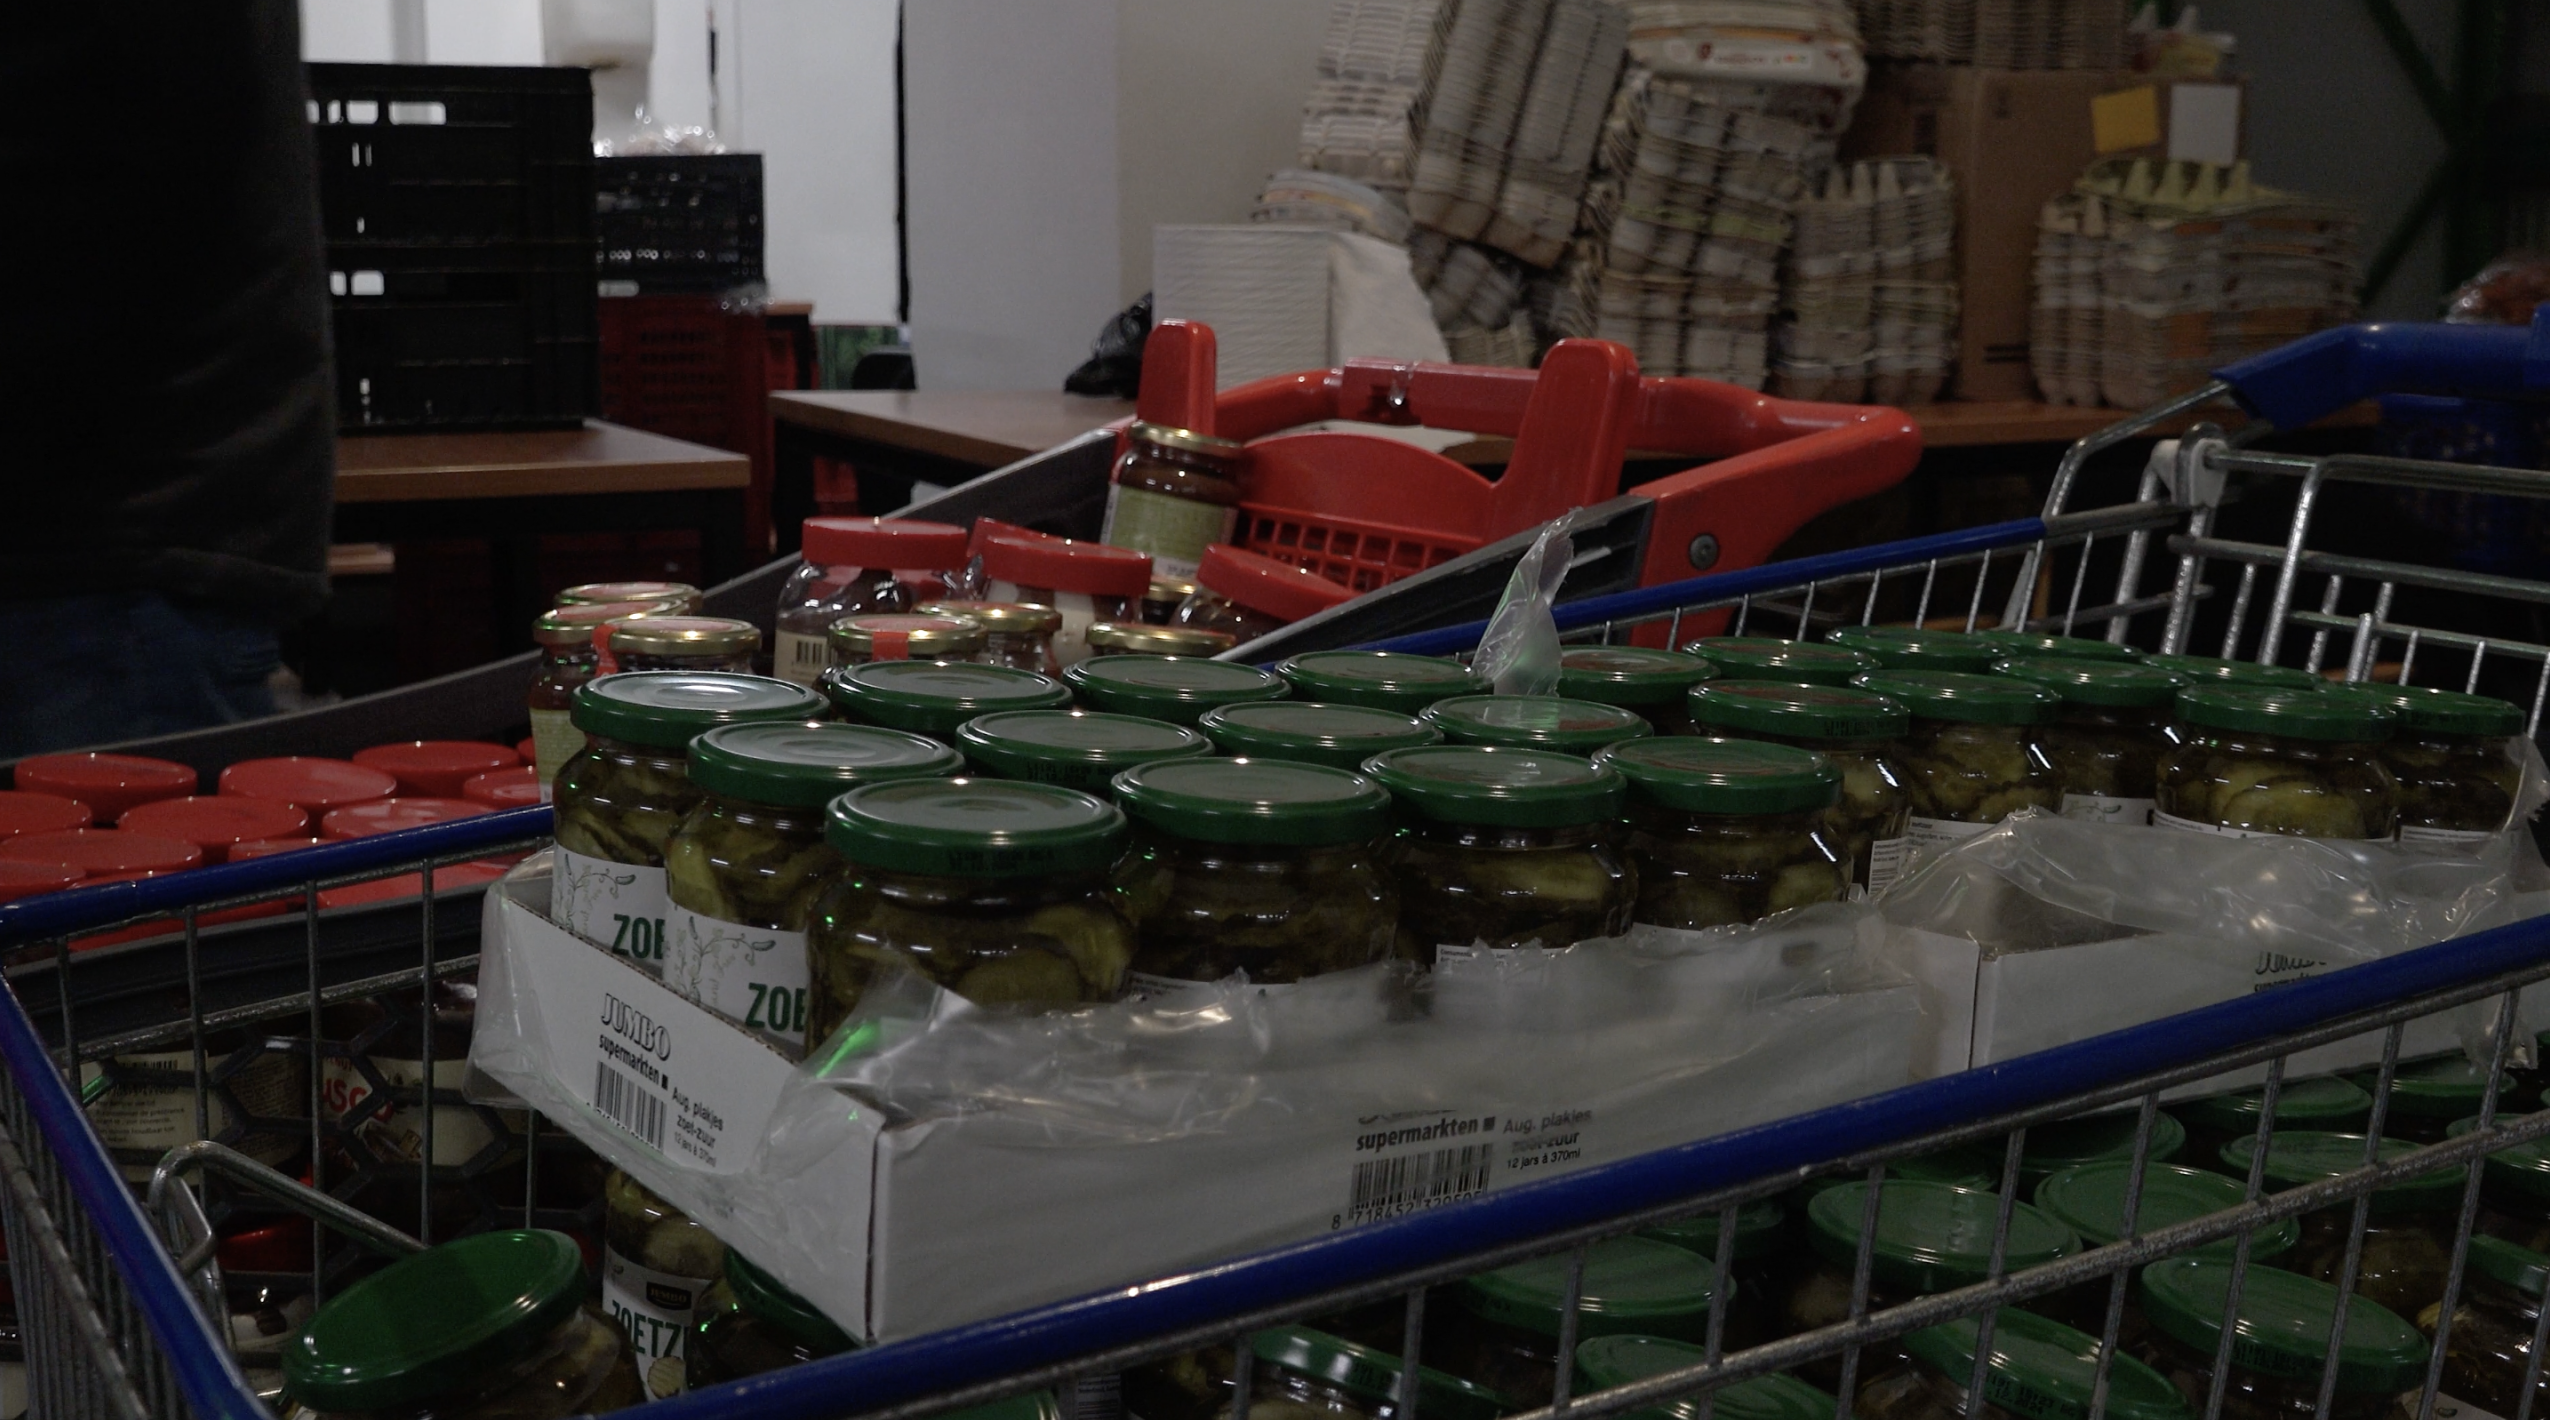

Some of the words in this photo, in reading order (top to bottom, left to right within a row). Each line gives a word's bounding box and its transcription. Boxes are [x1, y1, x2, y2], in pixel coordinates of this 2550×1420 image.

[601, 992, 671, 1062] JUMBO
[599, 1034, 660, 1086] supermarkten
[672, 1086, 691, 1113] Aug.
[693, 1101, 725, 1132] plakjes
[1503, 1117, 1537, 1135] Aug.
[676, 1114, 716, 1150] zoet-zuur
[1356, 1116, 1478, 1153] supermarkten
[1507, 1157, 1520, 1169] 12
[1520, 1155, 1540, 1170] jars
[1550, 1147, 1582, 1163] 370ml
[1331, 1213, 1342, 1230] 8
